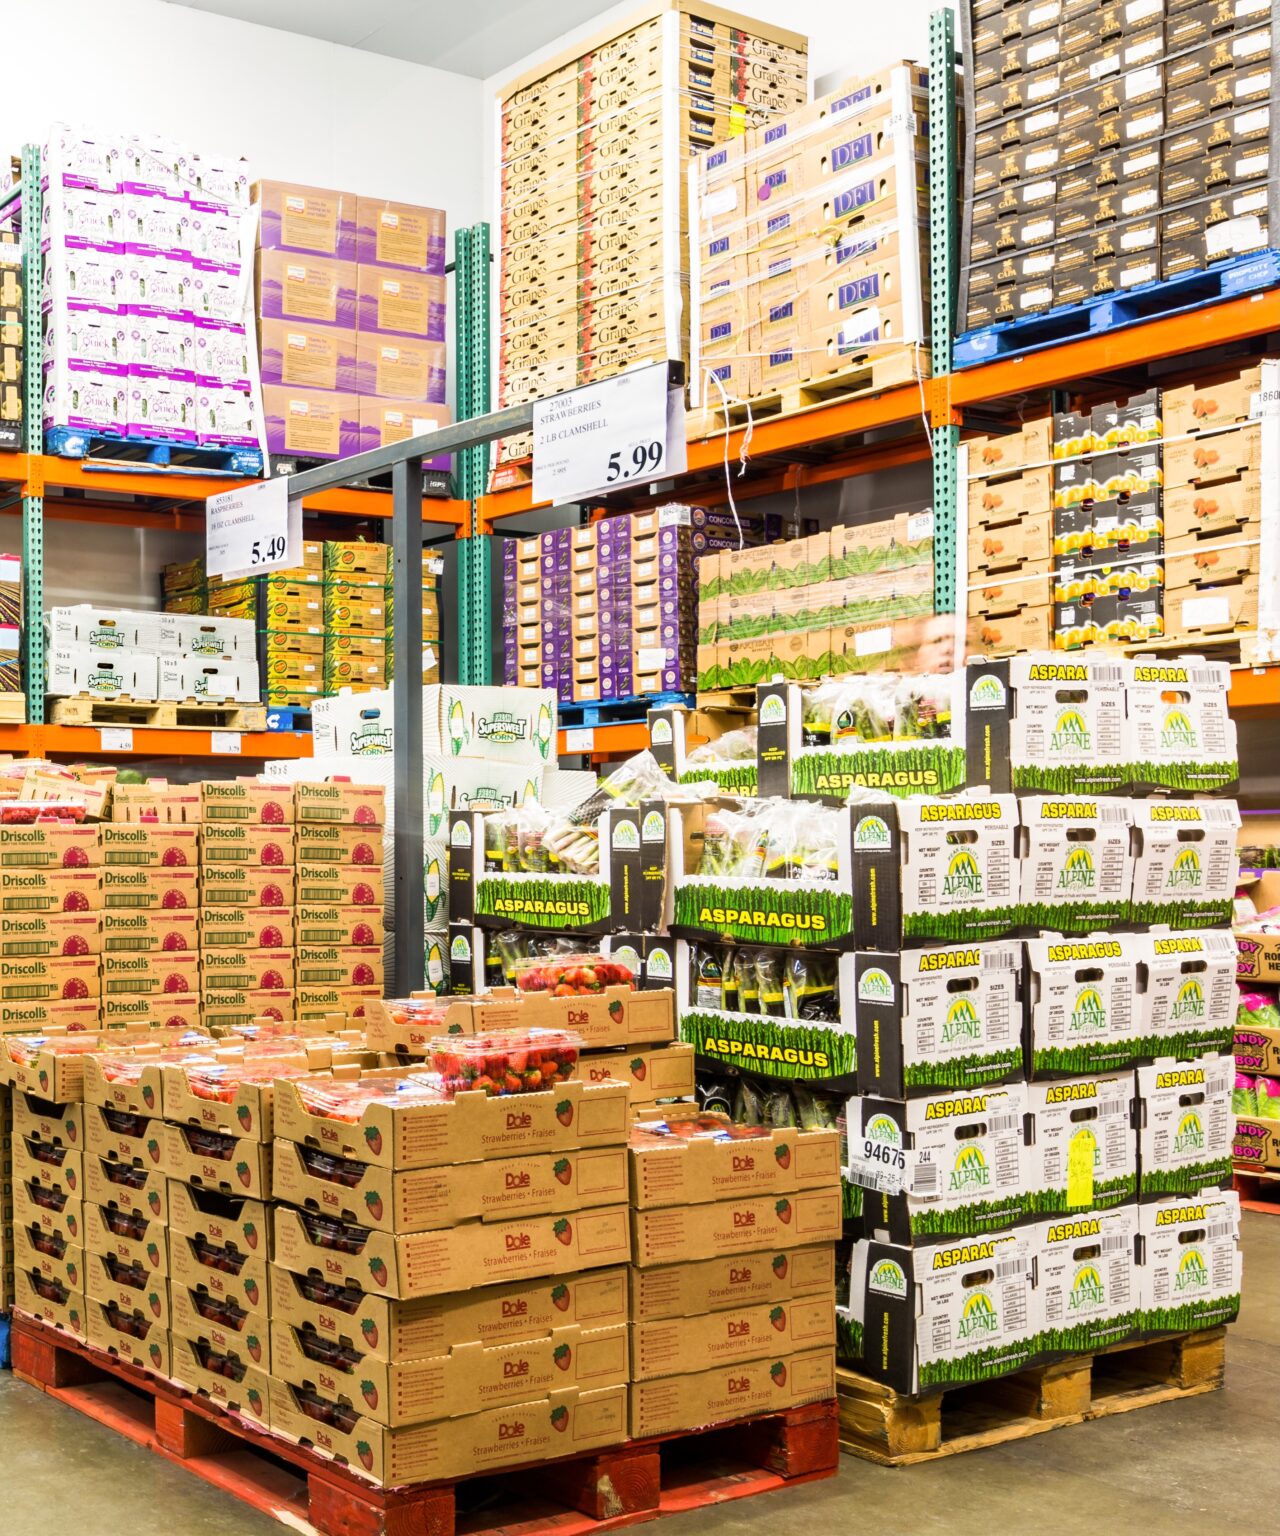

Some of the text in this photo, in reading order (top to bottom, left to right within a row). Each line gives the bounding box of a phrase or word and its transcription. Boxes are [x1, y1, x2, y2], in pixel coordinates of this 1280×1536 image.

[752, 39, 788, 62] Grapes
[598, 61, 640, 88] Grapes
[752, 87, 788, 109] Grapes
[834, 134, 872, 172] DFI
[835, 181, 875, 217] DFI
[512, 201, 549, 218] Grapes
[841, 276, 878, 308] DFI
[598, 325, 639, 346] Grapes
[540, 400, 601, 425] STRAWBERRIES
[549, 397, 572, 412] 27003
[540, 418, 608, 445] 2 LB CLAMSHELL
[607, 441, 663, 482] 5.99
[210, 501, 243, 515] RASPBERRIES
[225, 514, 255, 526] CLAMSHELL
[252, 537, 286, 564] 5.49
[1029, 664, 1088, 680] ASPARA
[478, 719, 527, 736] SUPERSWEET
[489, 734, 514, 742] CORN
[1049, 731, 1091, 750] ALPINE
[362, 747, 383, 756] CORN
[816, 770, 938, 789] ASPARAGUS
[206, 784, 246, 797] Driscoll's
[301, 786, 340, 797] Driscoll's
[920, 803, 1001, 822] ASPARAGUS
[1, 830, 45, 842] Driscoll's
[105, 829, 147, 841] Driscoll's
[206, 868, 246, 880] Driscoll's
[942, 875, 982, 895] ALPINE
[301, 909, 339, 920] Driscoll's
[494, 899, 590, 915] ASPARAGUS
[700, 908, 826, 930] ASPARAGUS
[1048, 941, 1121, 962] ASPARAGUS
[2, 963, 47, 974] Driscoll's
[940, 1021, 981, 1043] ALPINE
[704, 1038, 828, 1068] ASPARAGUS
[506, 1112, 532, 1127] Dole
[321, 1127, 339, 1139] Dole
[481, 1127, 556, 1145] Strawberries Fraises
[732, 1156, 754, 1168] Dole
[864, 1140, 905, 1169] 94676
[919, 1152, 931, 1163] 244
[505, 1172, 530, 1187] Dole
[712, 1171, 776, 1185] Strawberries Fraises
[948, 1167, 990, 1191] ALPINE
[481, 1186, 556, 1205] Strawberries Fraises
[956, 1313, 998, 1339] ALPINE
[498, 1421, 525, 1437] Dole
[472, 1435, 551, 1456] Strawberries Fraises
